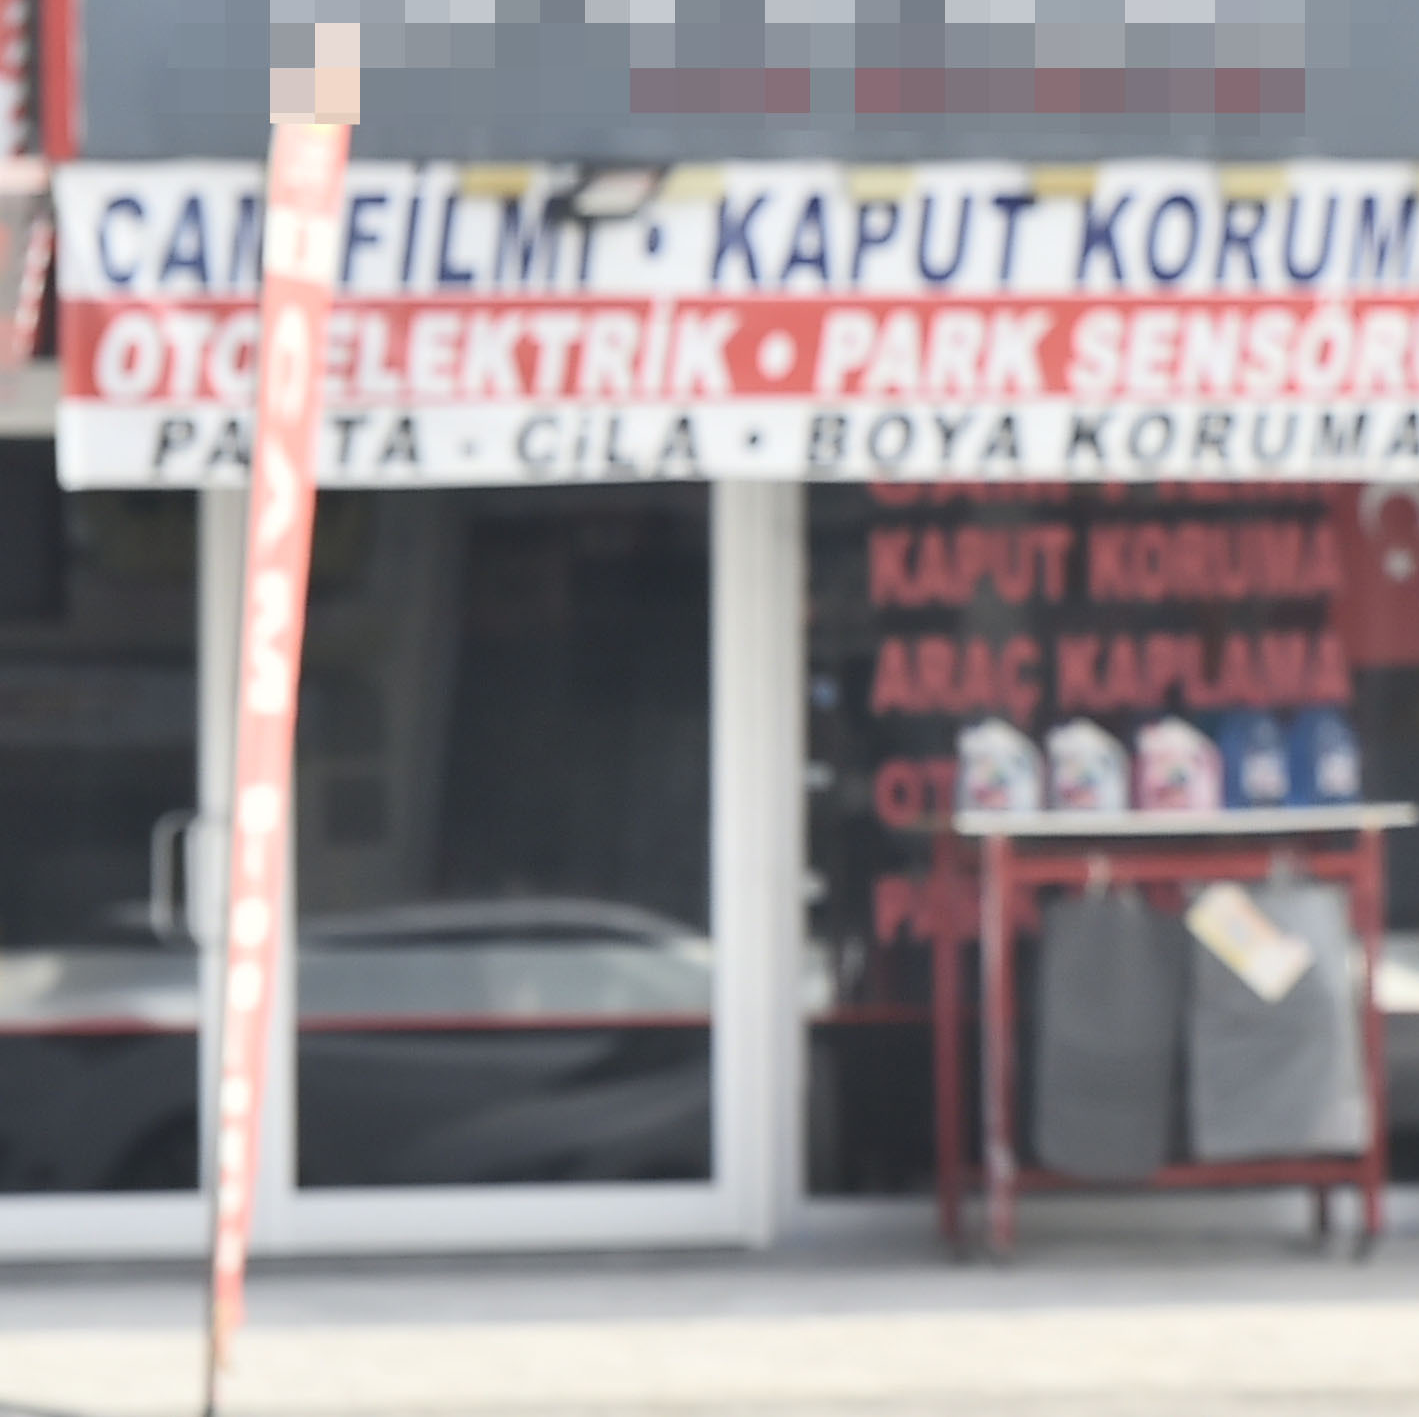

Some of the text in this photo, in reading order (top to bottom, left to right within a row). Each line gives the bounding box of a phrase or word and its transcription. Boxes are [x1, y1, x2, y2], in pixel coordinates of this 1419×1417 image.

[711, 194, 1036, 283] KAPUT
[812, 305, 1053, 399] PARK
[152, 415, 420, 467] PATA
[806, 412, 1024, 465] BOYA
[872, 525, 1074, 605] KAPUT
